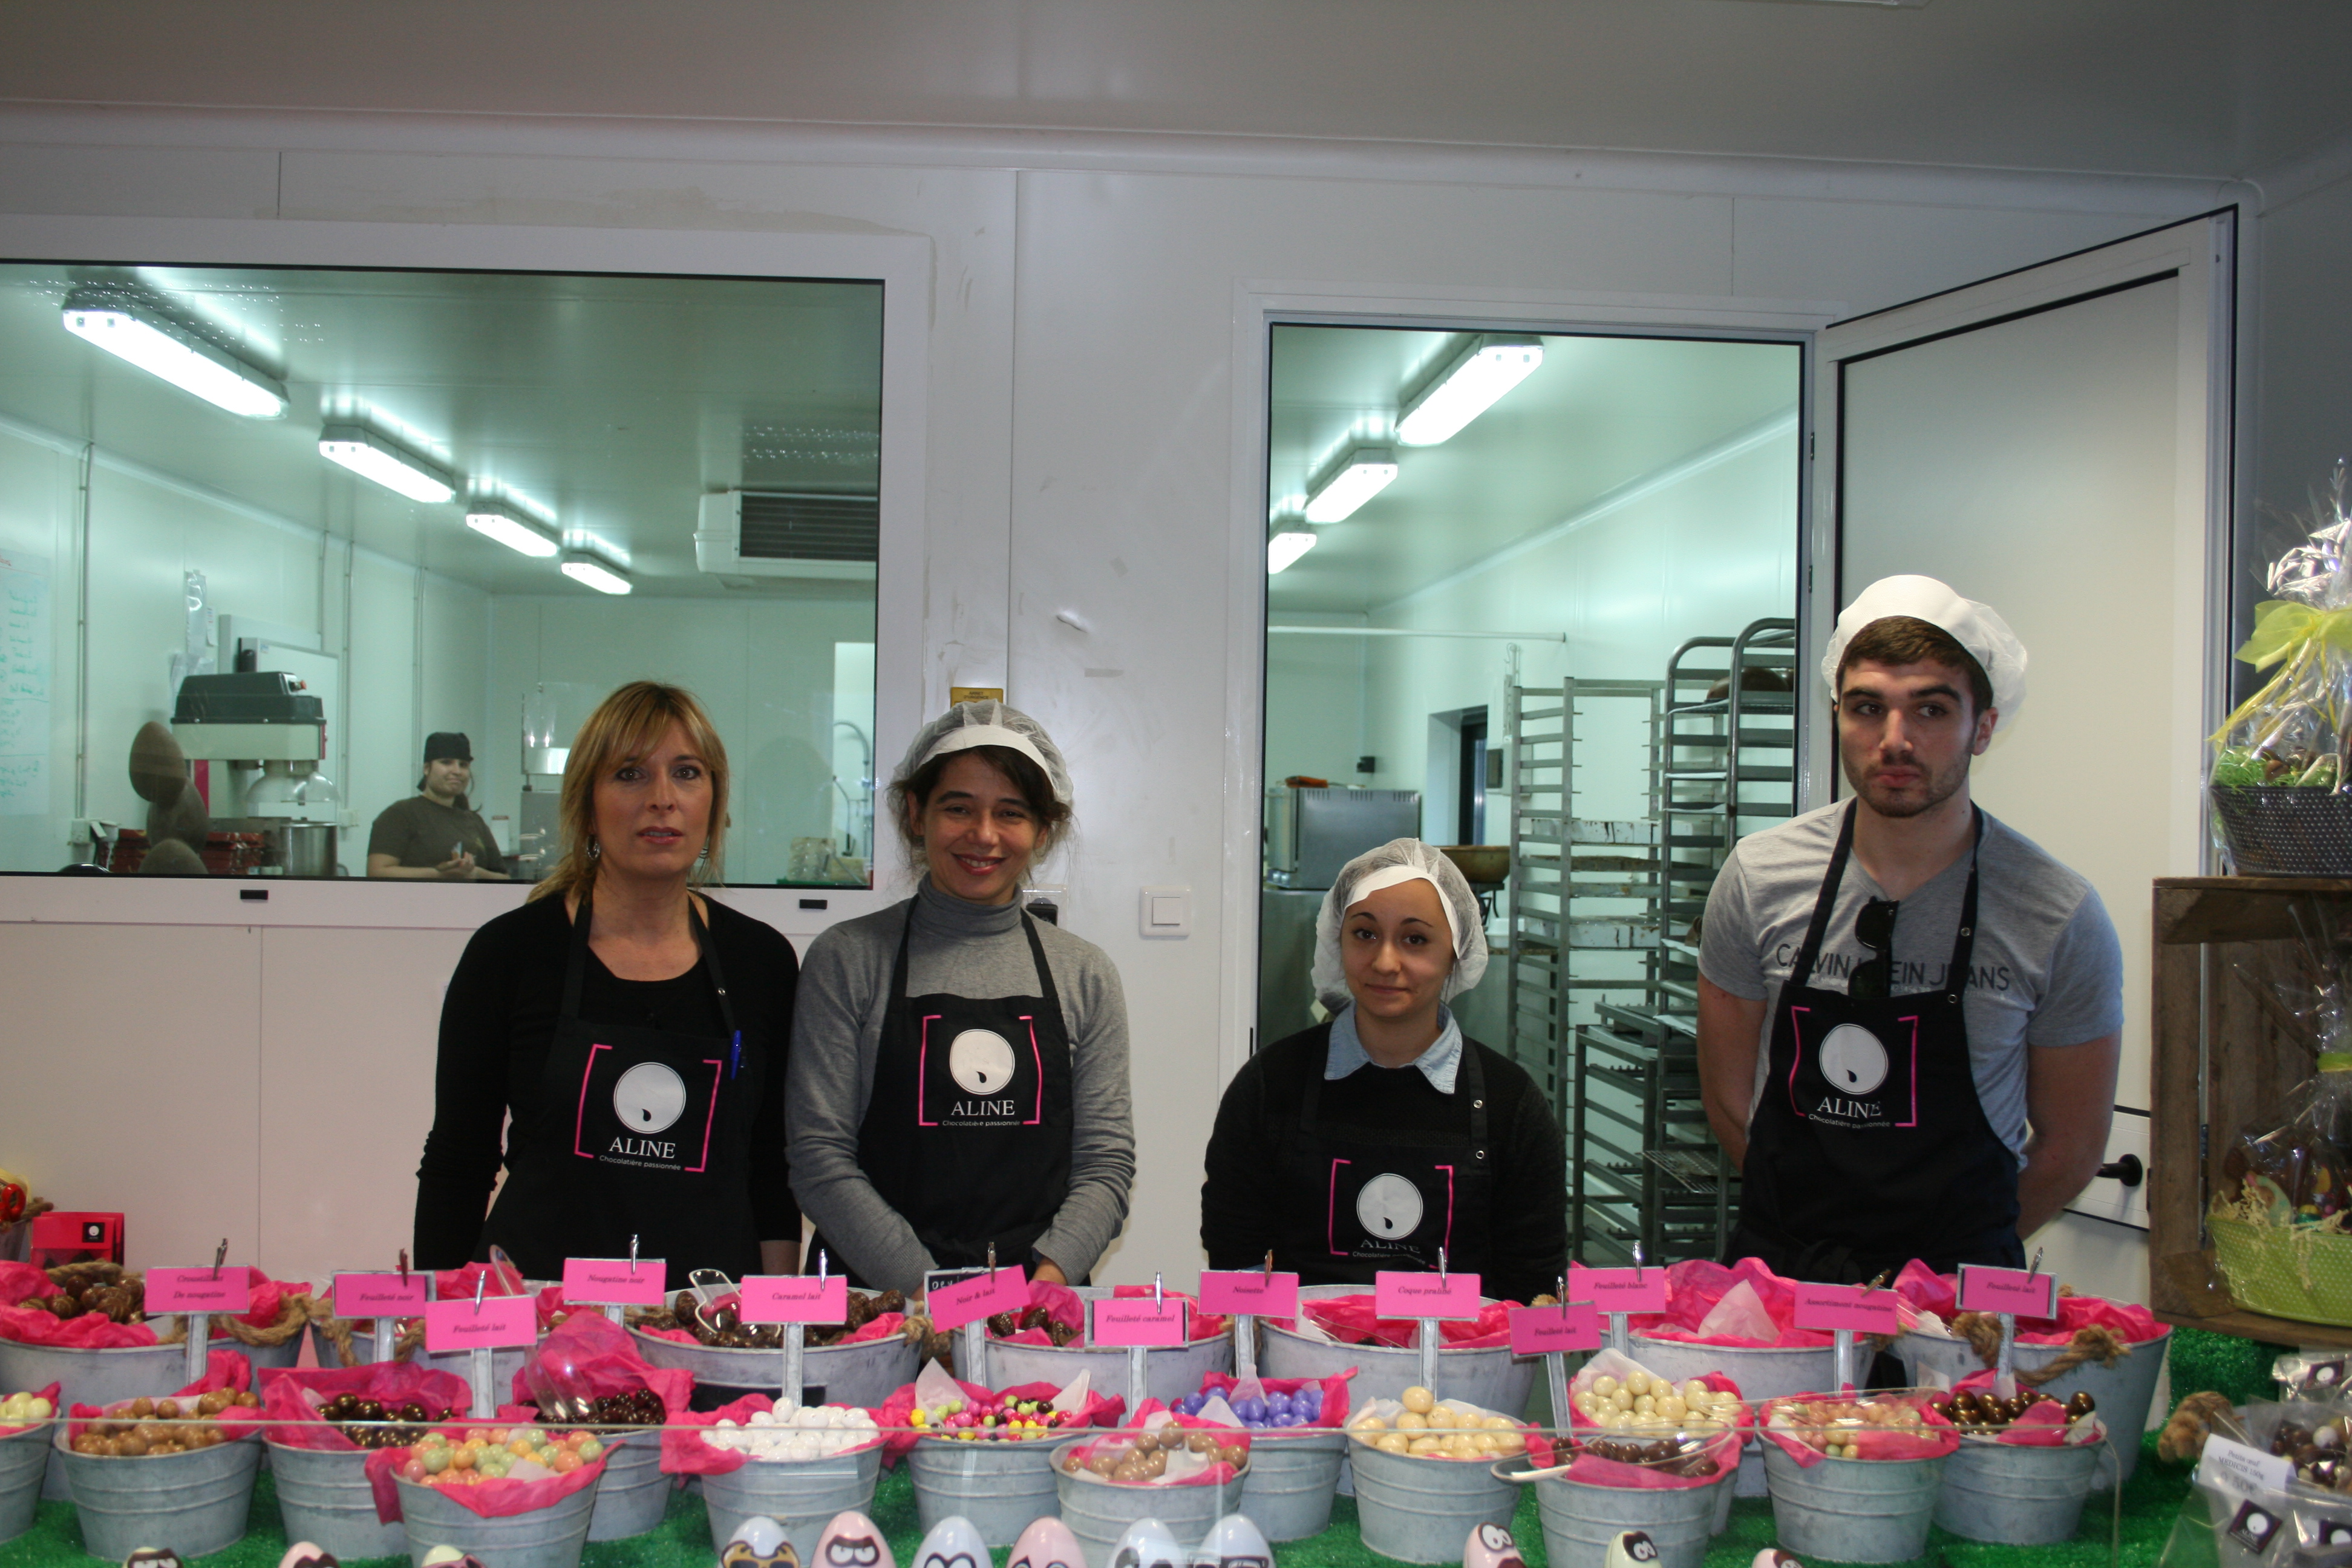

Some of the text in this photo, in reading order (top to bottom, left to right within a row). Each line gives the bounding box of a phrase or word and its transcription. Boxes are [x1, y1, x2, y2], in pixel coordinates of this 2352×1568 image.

[1776, 944, 1851, 979] CAVIN
[1930, 962, 2010, 991] JANS
[951, 1100, 1015, 1116] ALINE
[1817, 1097, 1881, 1119] ALINE
[1808, 1113, 1851, 1128] Chocolatière
[609, 1137, 676, 1159] ALINE
[599, 1155, 681, 1171] Chocolatière passionnée
[1361, 1239, 1421, 1254] ALINE
[587, 1274, 627, 1284] Nougatine
[1398, 1286, 1451, 1295] Coque praliné
[1987, 1282, 2020, 1292] Feuilleté
[956, 1296, 972, 1305] Noir
[983, 1288, 995, 1296] lait
[1854, 1303, 1892, 1312] nougatine
[1106, 1315, 1141, 1323] Feuilleté
[454, 1324, 489, 1333] Feuilleté
[2228, 1449, 2246, 1463] Petits
[2218, 1456, 2264, 1481] MEDICIS 150g
